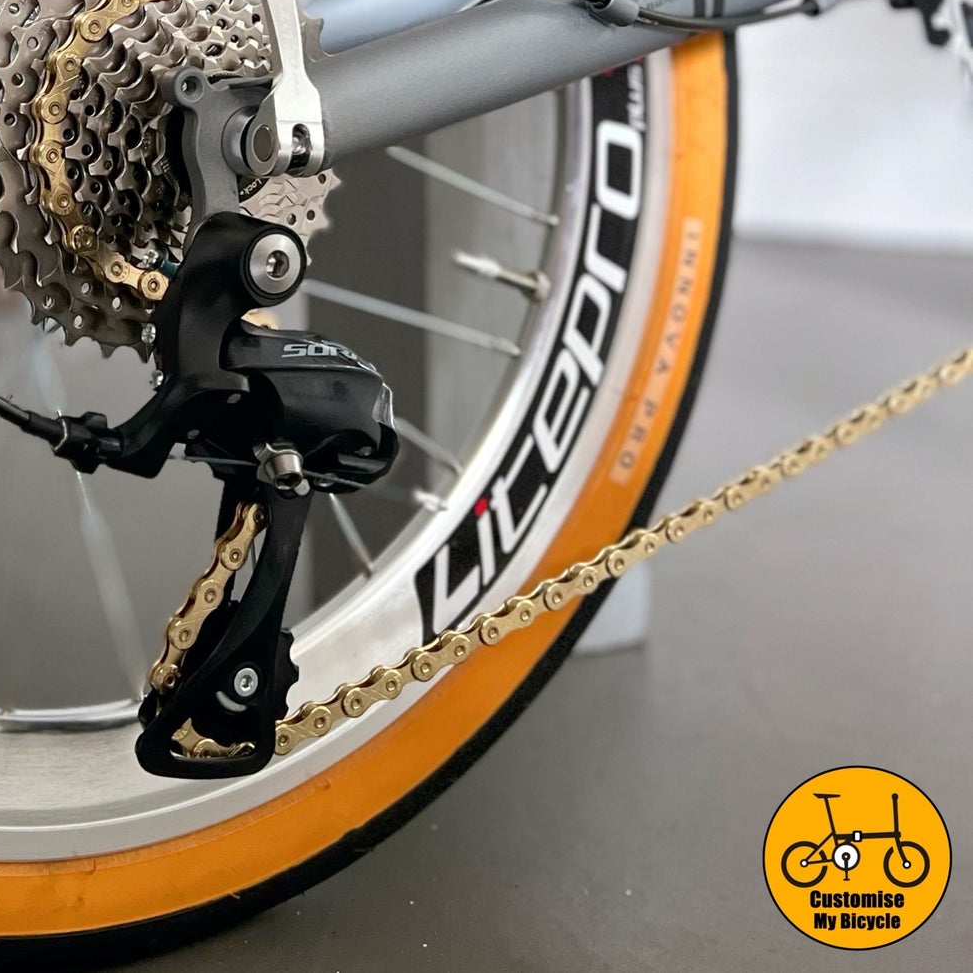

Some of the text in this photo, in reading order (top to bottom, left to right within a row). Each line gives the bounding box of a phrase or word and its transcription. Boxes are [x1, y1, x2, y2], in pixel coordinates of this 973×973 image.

[242, 177, 264, 196] Lock
[280, 341, 360, 359] SOR
[432, 120, 644, 635] Litepro
[617, 230, 699, 471] INNOVA PRO
